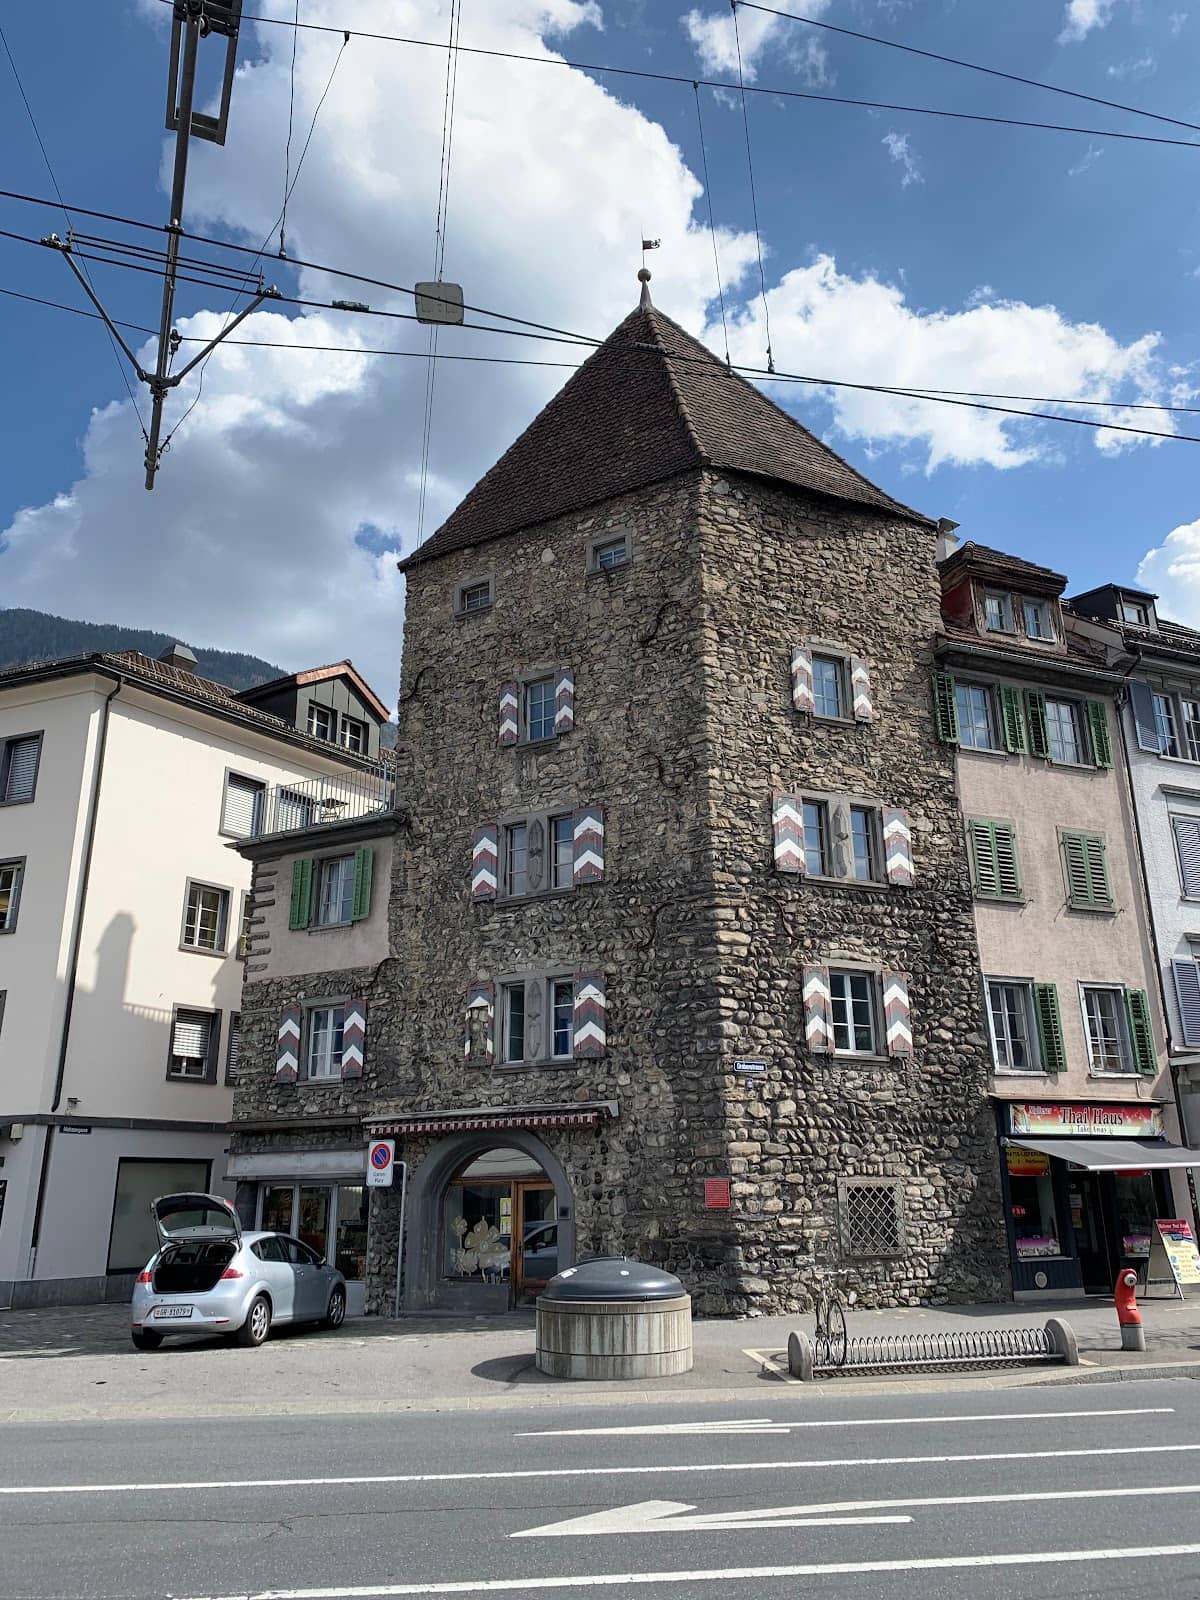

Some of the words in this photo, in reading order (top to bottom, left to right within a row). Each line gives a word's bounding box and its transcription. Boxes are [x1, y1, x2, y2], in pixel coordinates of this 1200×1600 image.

[1060, 1106, 1088, 1124] Thai
[1093, 1107, 1123, 1125] Haus
[1077, 1125, 1090, 1133] Take
[1092, 1126, 1107, 1135] Away
